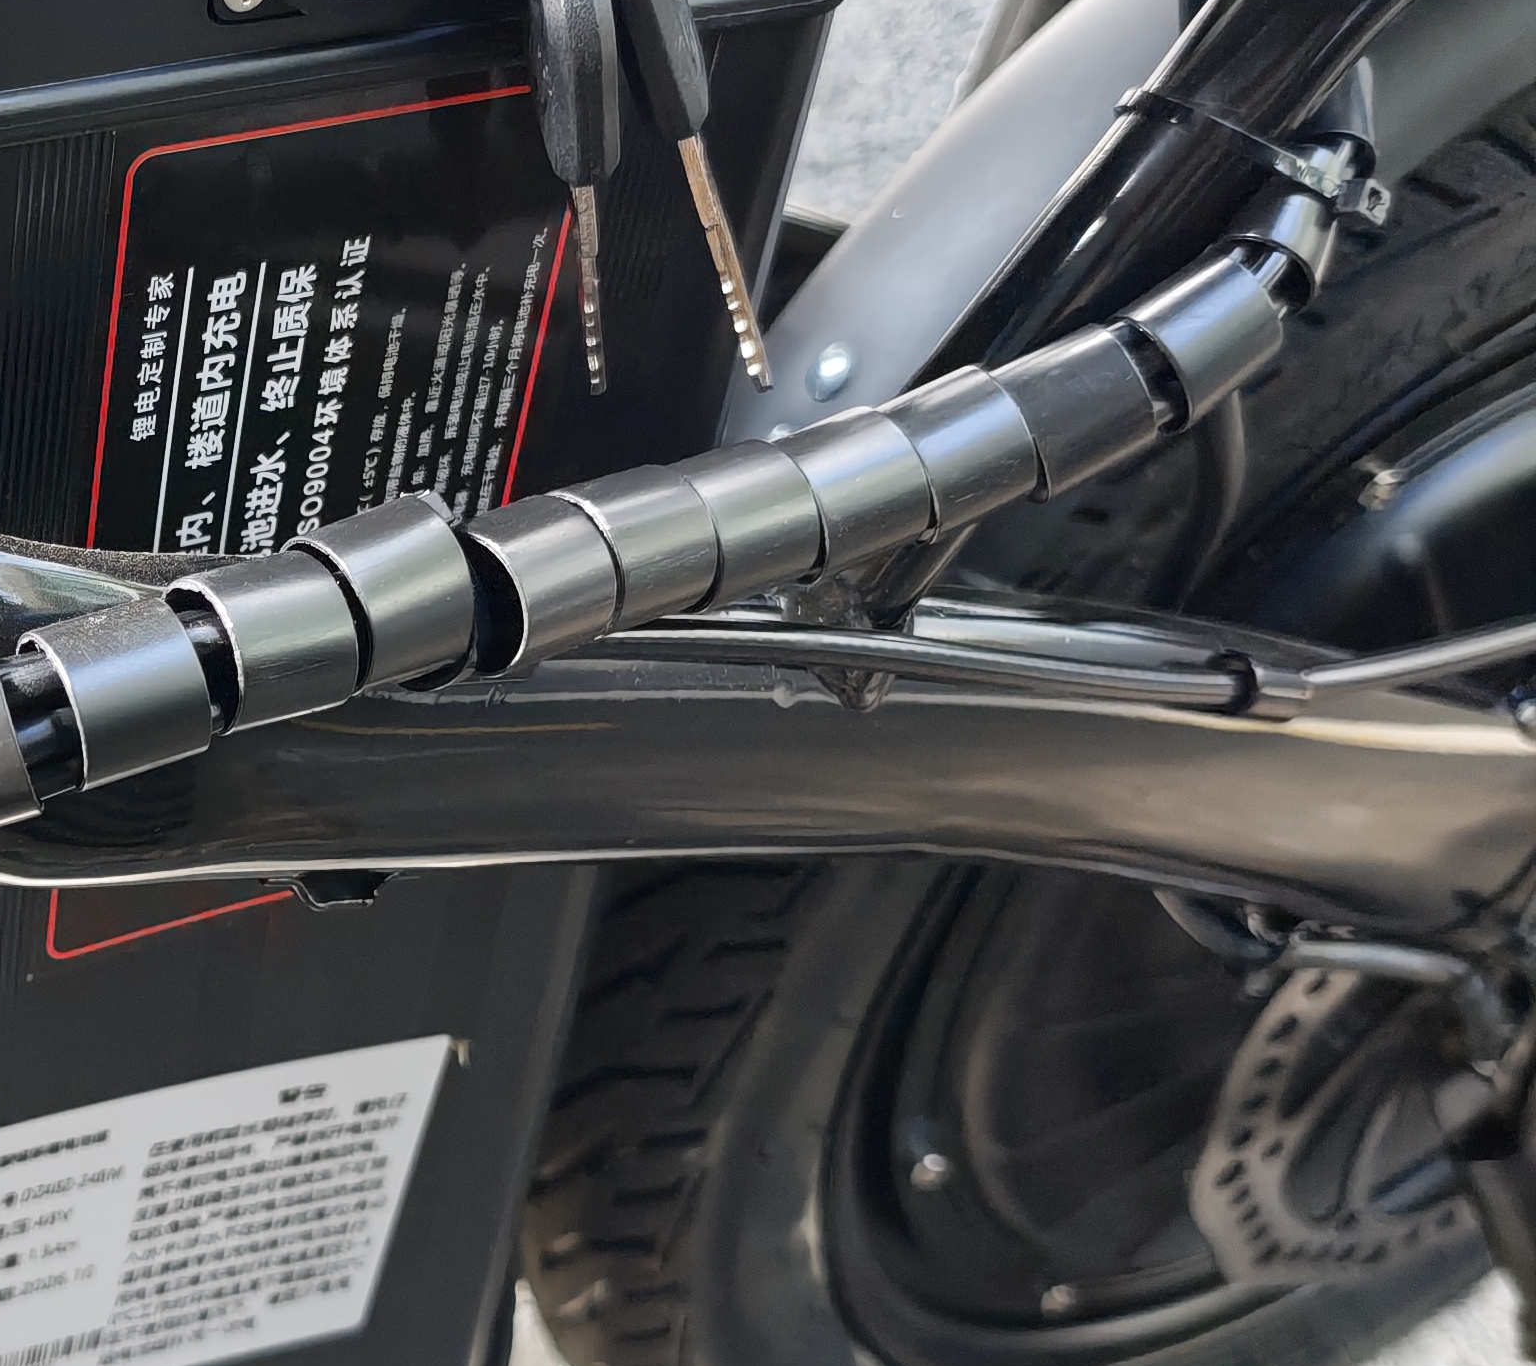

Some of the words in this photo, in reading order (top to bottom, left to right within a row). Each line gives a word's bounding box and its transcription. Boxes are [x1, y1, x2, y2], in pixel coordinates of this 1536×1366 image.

[129, 272, 175, 441] 锂电定制专家
[175, 270, 247, 555] 内、楼道内充电
[240, 264, 317, 557] 池进水、终止质保
